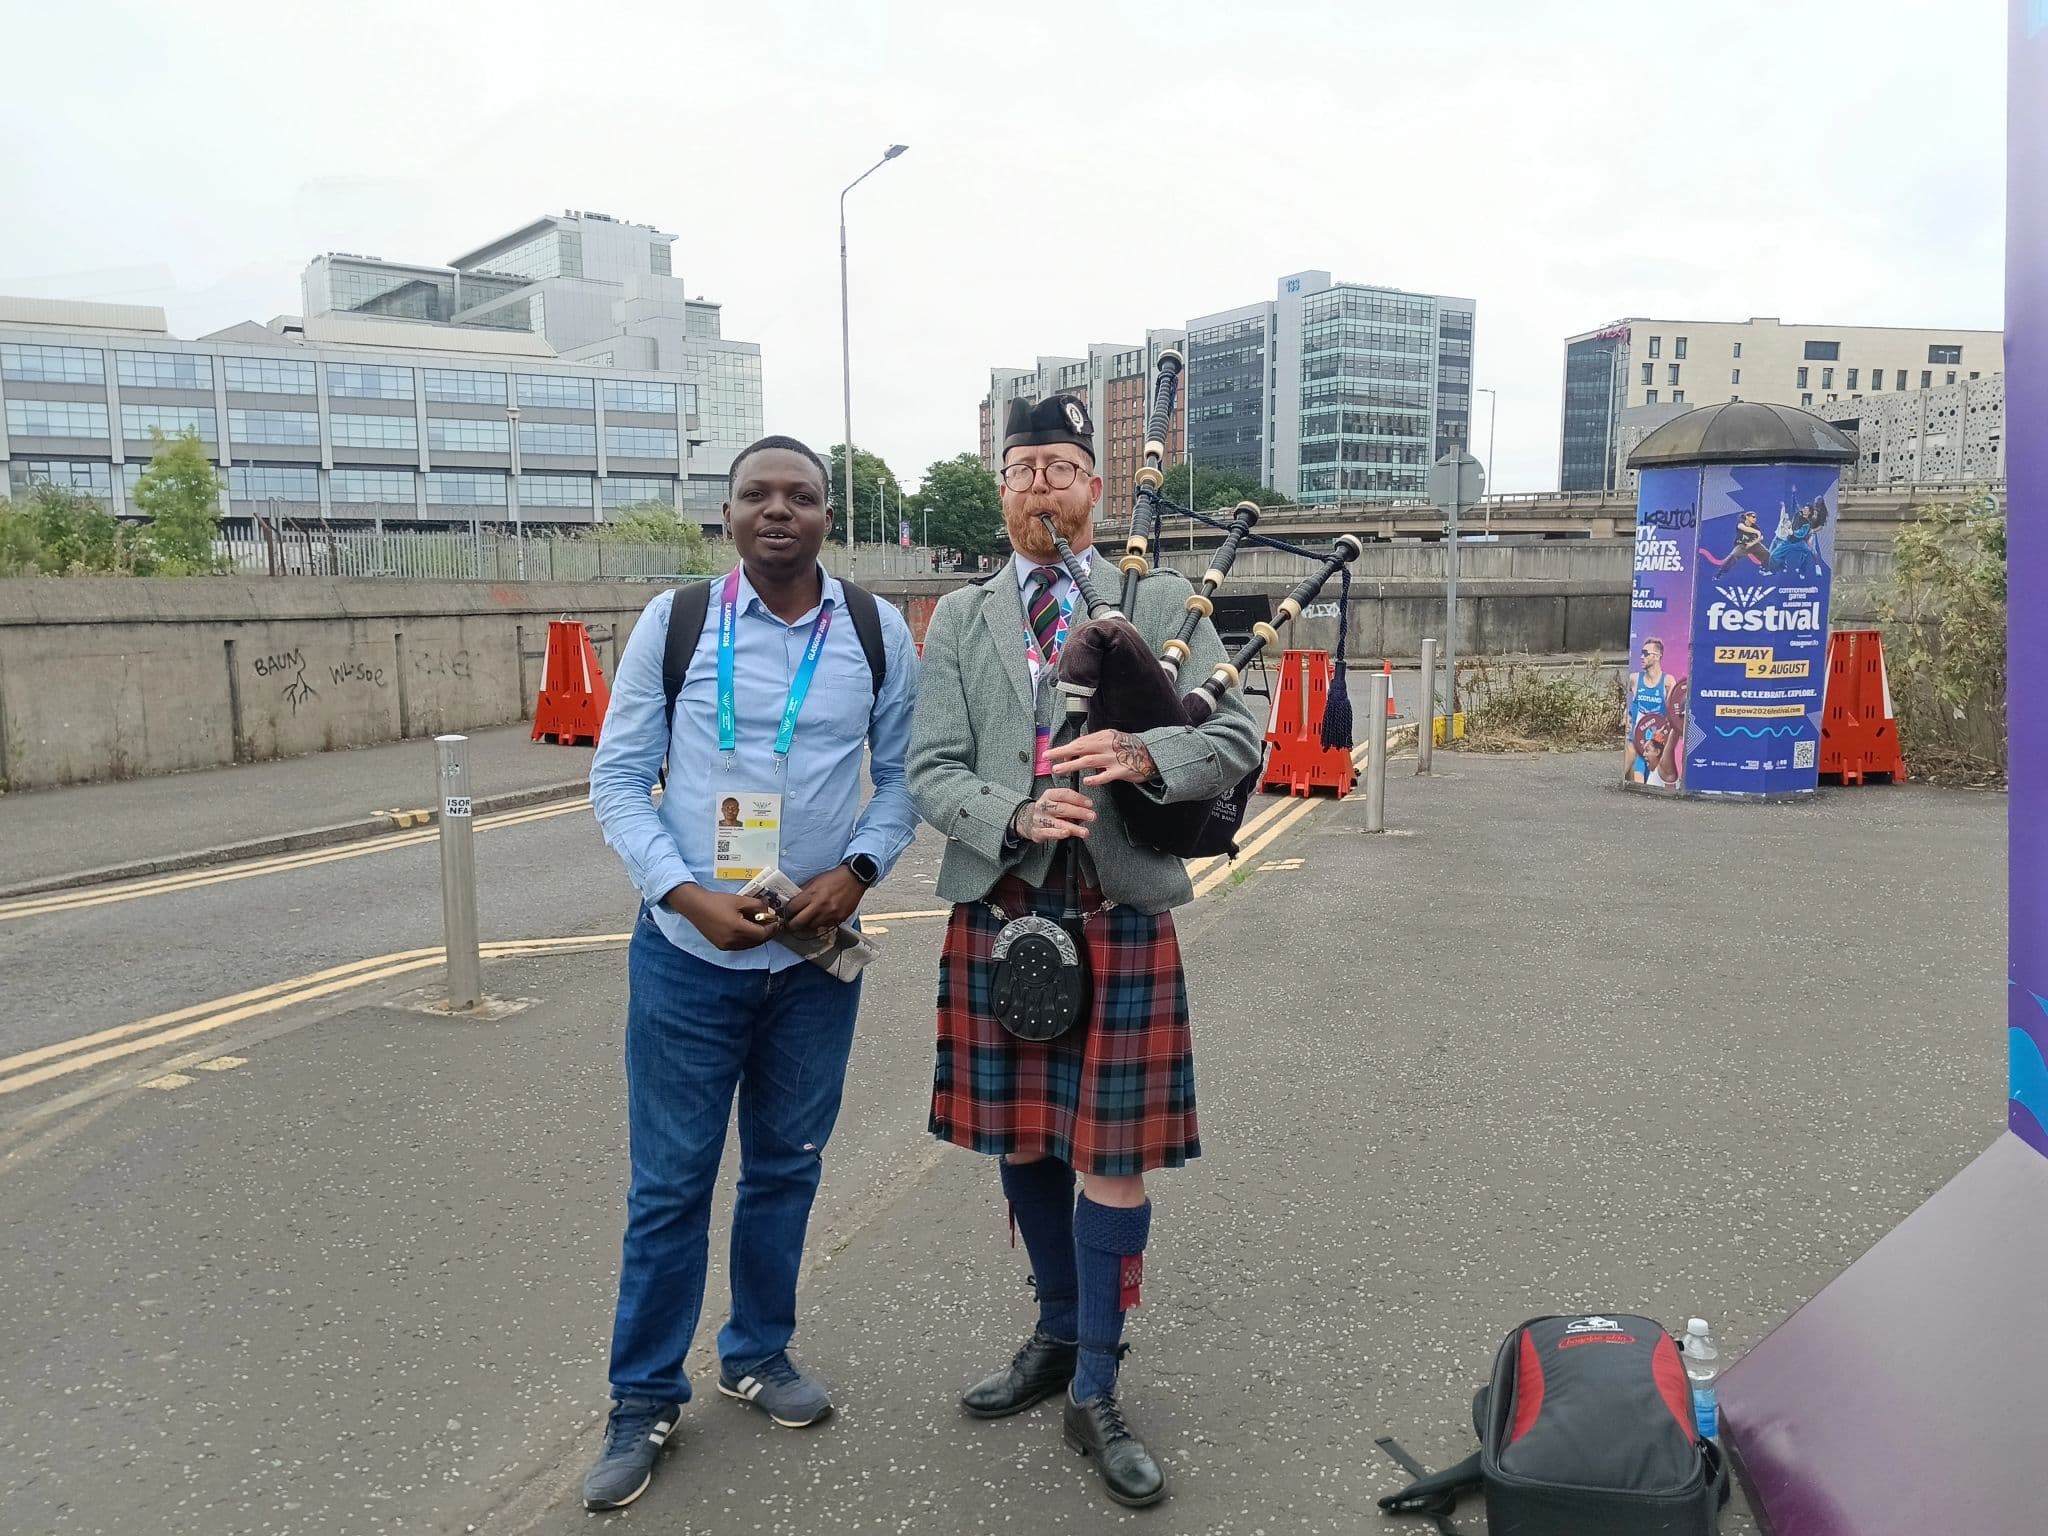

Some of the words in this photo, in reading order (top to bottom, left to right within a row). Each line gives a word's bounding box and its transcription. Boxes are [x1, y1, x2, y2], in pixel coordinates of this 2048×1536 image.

[1635, 555, 1685, 572] GAMES.
[723, 602, 732, 632] GLASGOW
[1706, 601, 1820, 631] festival
[807, 631, 822, 661] GLASGOW
[1718, 649, 1735, 660] 23
[1738, 649, 1769, 660] MAY
[1758, 664, 1768, 675] 9
[1769, 663, 1807, 675] AUGUST
[1701, 689, 1740, 698] GATHER.
[1216, 799, 1238, 812] OLICE
